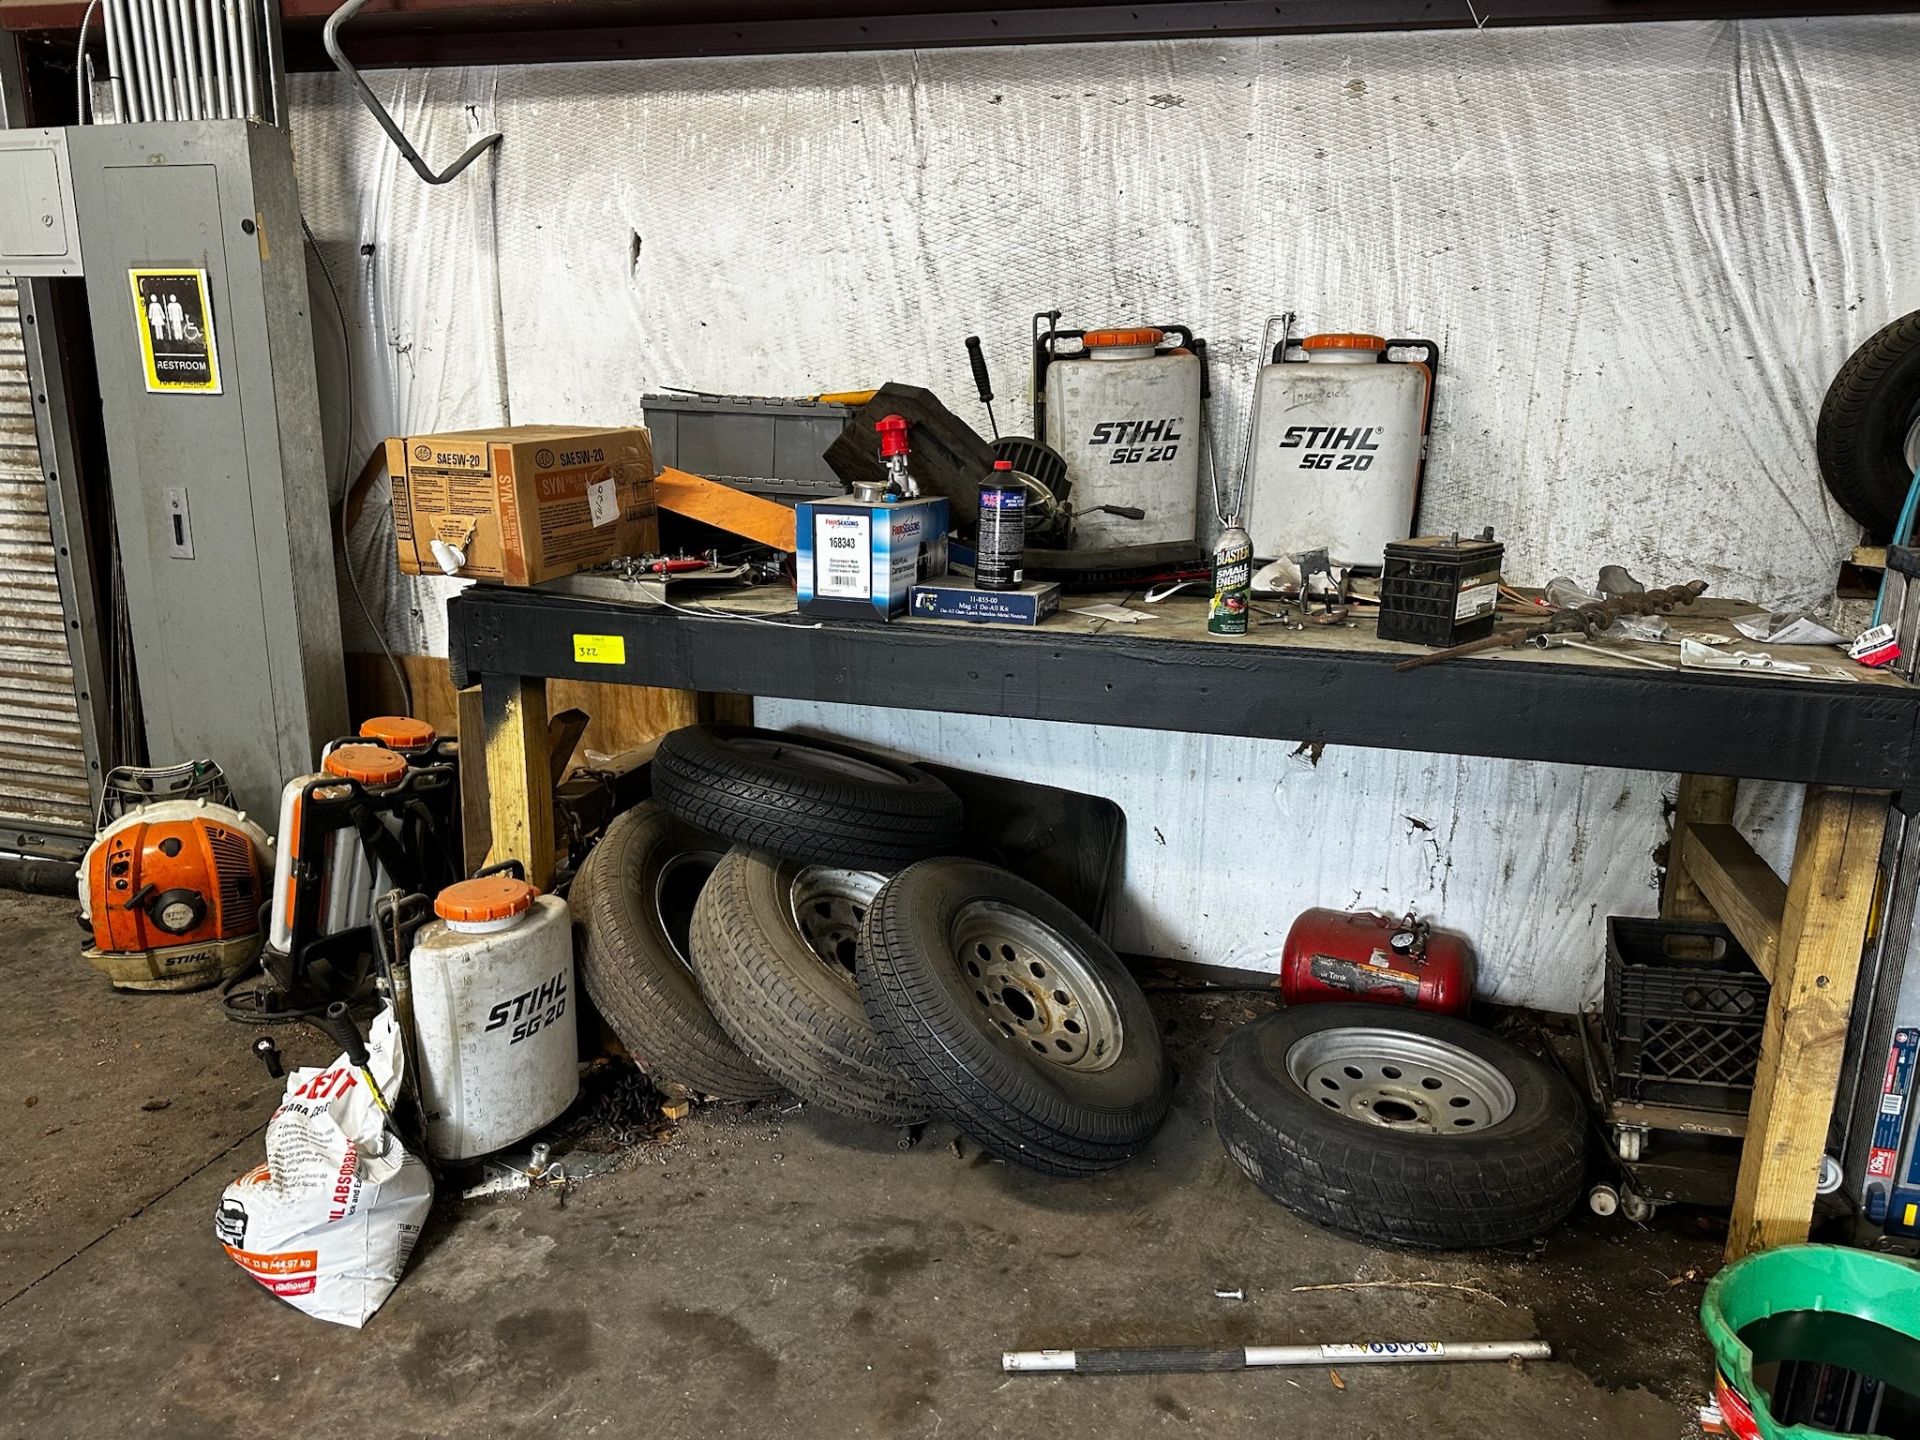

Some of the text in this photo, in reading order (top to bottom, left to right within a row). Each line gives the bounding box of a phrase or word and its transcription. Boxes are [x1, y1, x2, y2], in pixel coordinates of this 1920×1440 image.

[157, 361, 207, 370] RESTROOM
[1110, 445, 1178, 465] SG 20
[1299, 454, 1374, 471] SG 20
[499, 475, 512, 503] SYN
[829, 537, 855, 549] 168343
[1217, 563, 1249, 578] SMALL
[1216, 571, 1248, 588] ENGINE
[579, 647, 598, 656] 322
[165, 952, 210, 966] STIHL
[485, 970, 567, 1032] STIHL
[510, 998, 565, 1045] SG 20
[300, 1259, 311, 1270] kg
